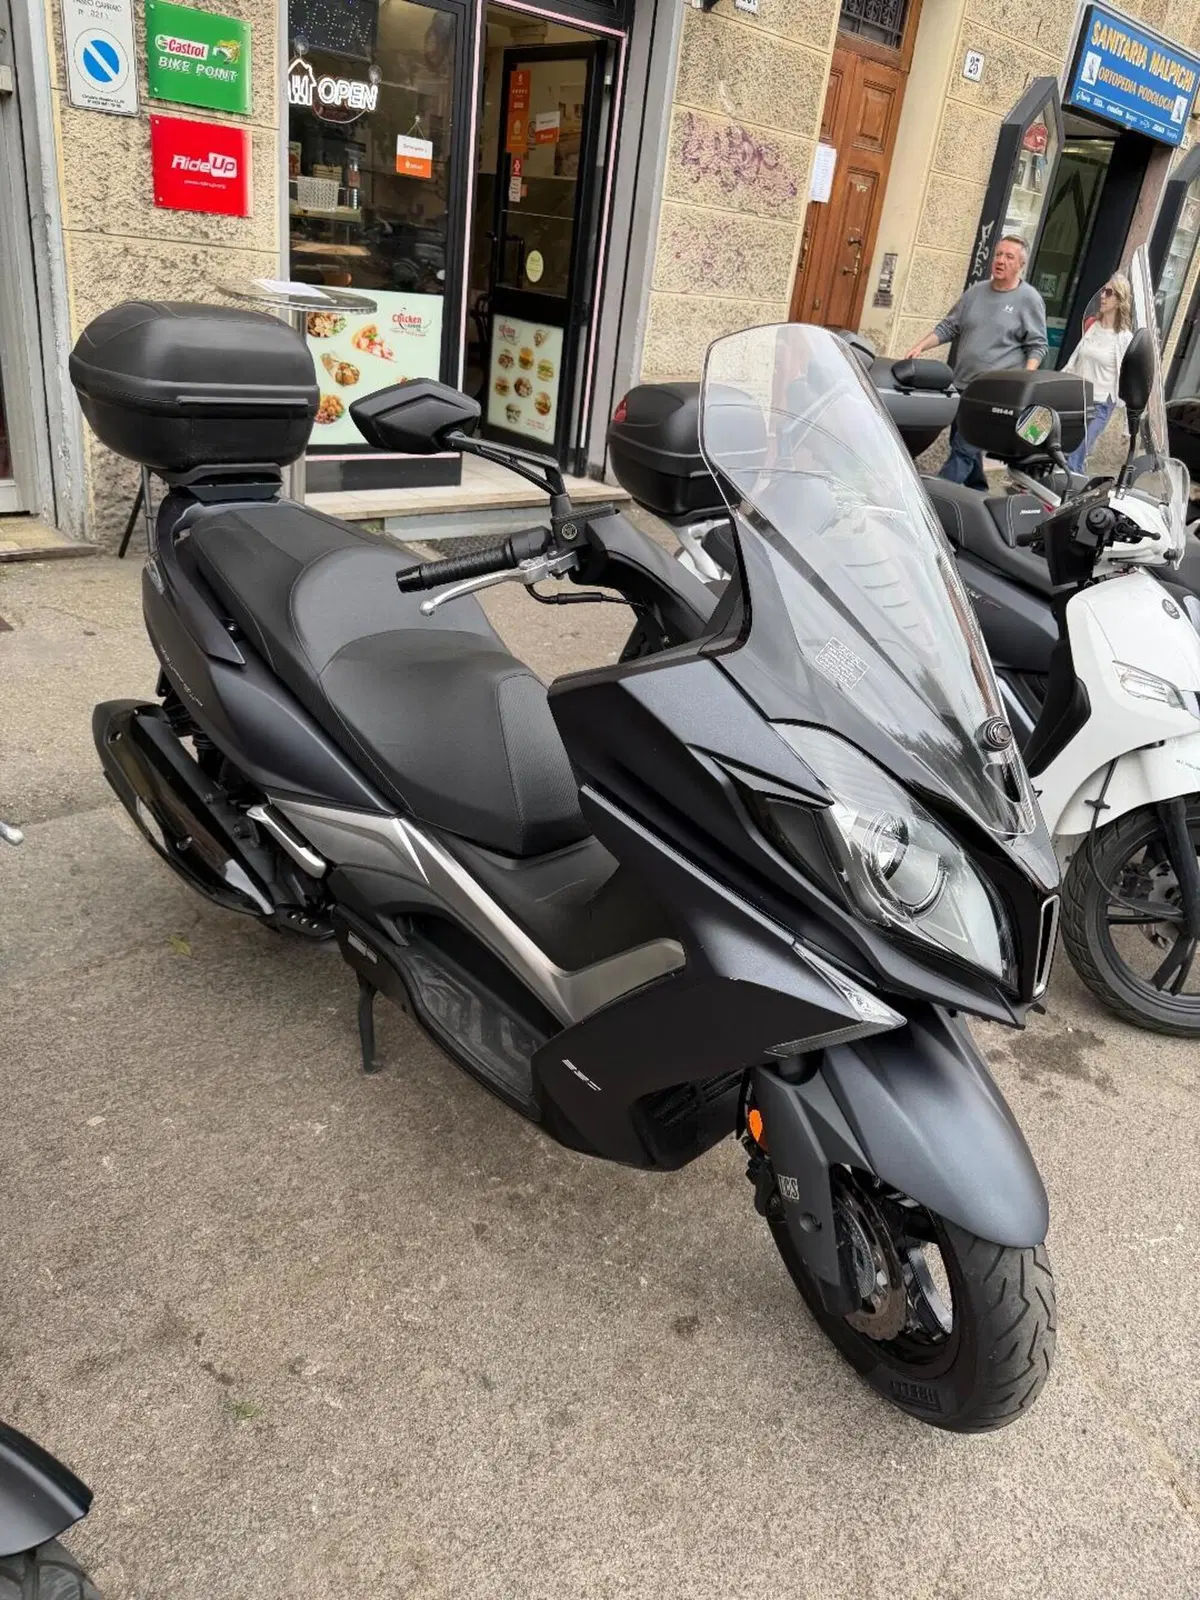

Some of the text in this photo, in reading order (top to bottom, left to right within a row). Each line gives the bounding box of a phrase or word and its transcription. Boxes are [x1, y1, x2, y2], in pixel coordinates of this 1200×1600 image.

[168, 39, 206, 58] Castrol
[1091, 19, 1149, 70] SANITARIA
[158, 56, 239, 82] BIKE POINT
[1098, 66, 1138, 96] ORTOPEDIA
[318, 77, 379, 111] OPEN
[171, 153, 236, 174] RideUp
